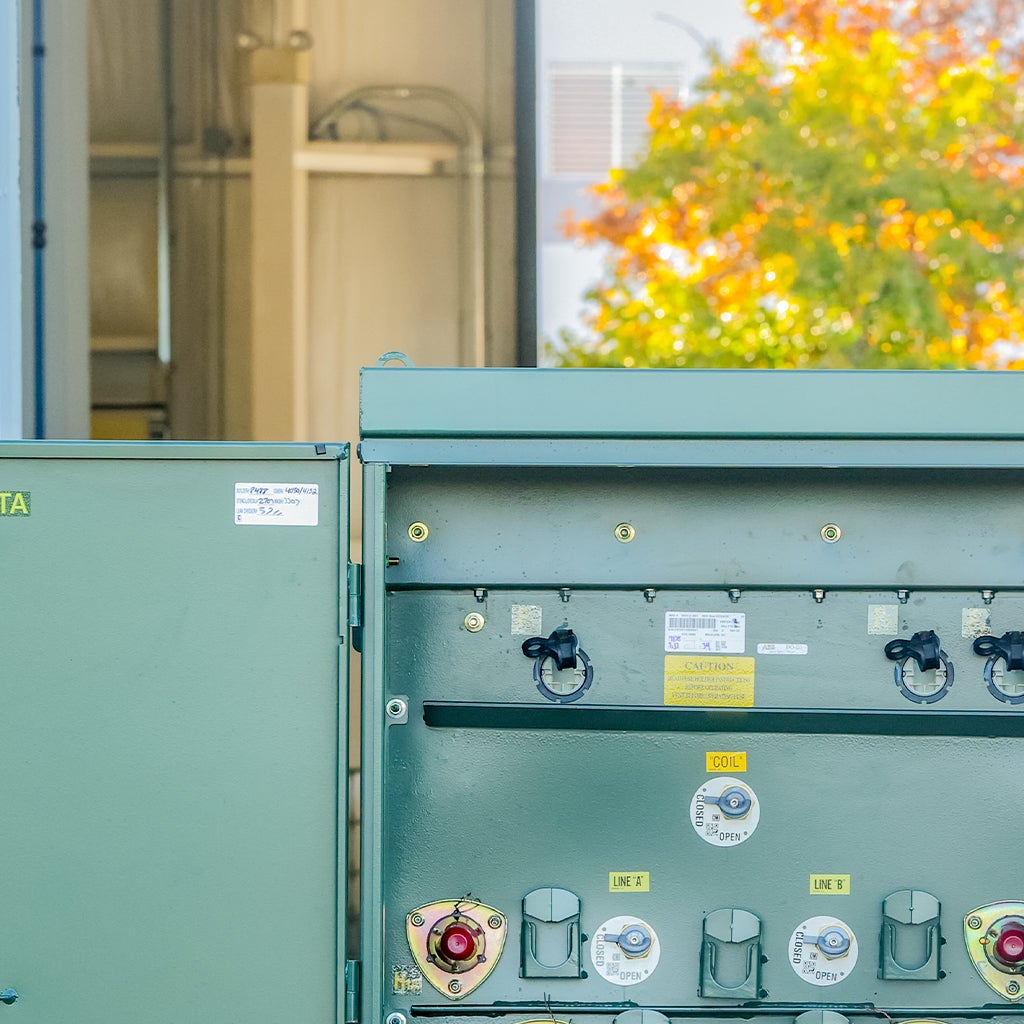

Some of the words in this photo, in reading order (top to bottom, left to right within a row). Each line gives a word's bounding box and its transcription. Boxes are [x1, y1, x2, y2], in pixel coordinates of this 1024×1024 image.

[0, 493, 29, 514] TA
[684, 662, 734, 670] CAUTION
[695, 794, 705, 827] CLOSED
[719, 832, 741, 841] OPEN
[613, 876, 631, 887] LINE
[814, 879, 832, 890] LINE
[595, 933, 605, 967] CLOSED
[792, 931, 805, 964] CLOSED
[620, 971, 642, 981] OPEN
[815, 971, 837, 982] OPEN
